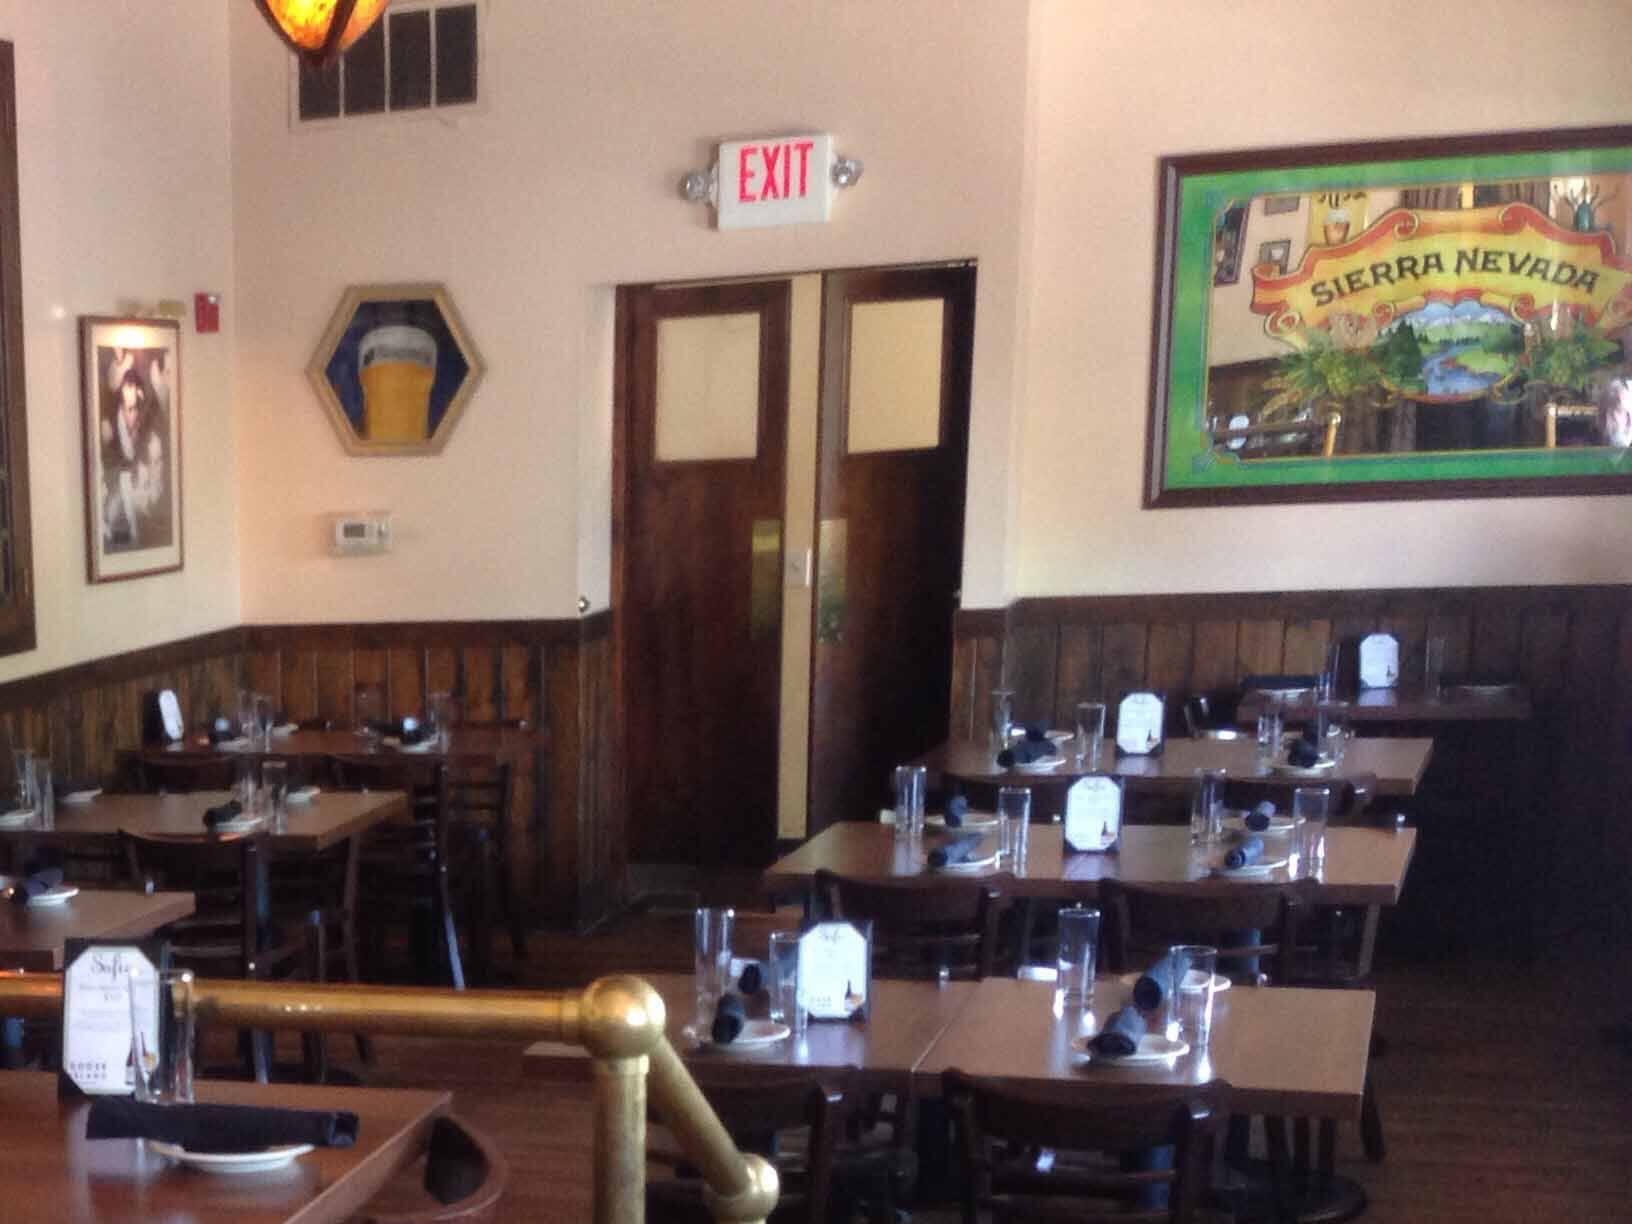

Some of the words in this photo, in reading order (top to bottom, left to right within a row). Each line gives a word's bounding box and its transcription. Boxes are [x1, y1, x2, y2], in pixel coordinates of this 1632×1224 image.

[738, 139, 814, 203] EXIT
[1310, 249, 1445, 307] SIERRA
[1453, 248, 1600, 293] NEVADA
